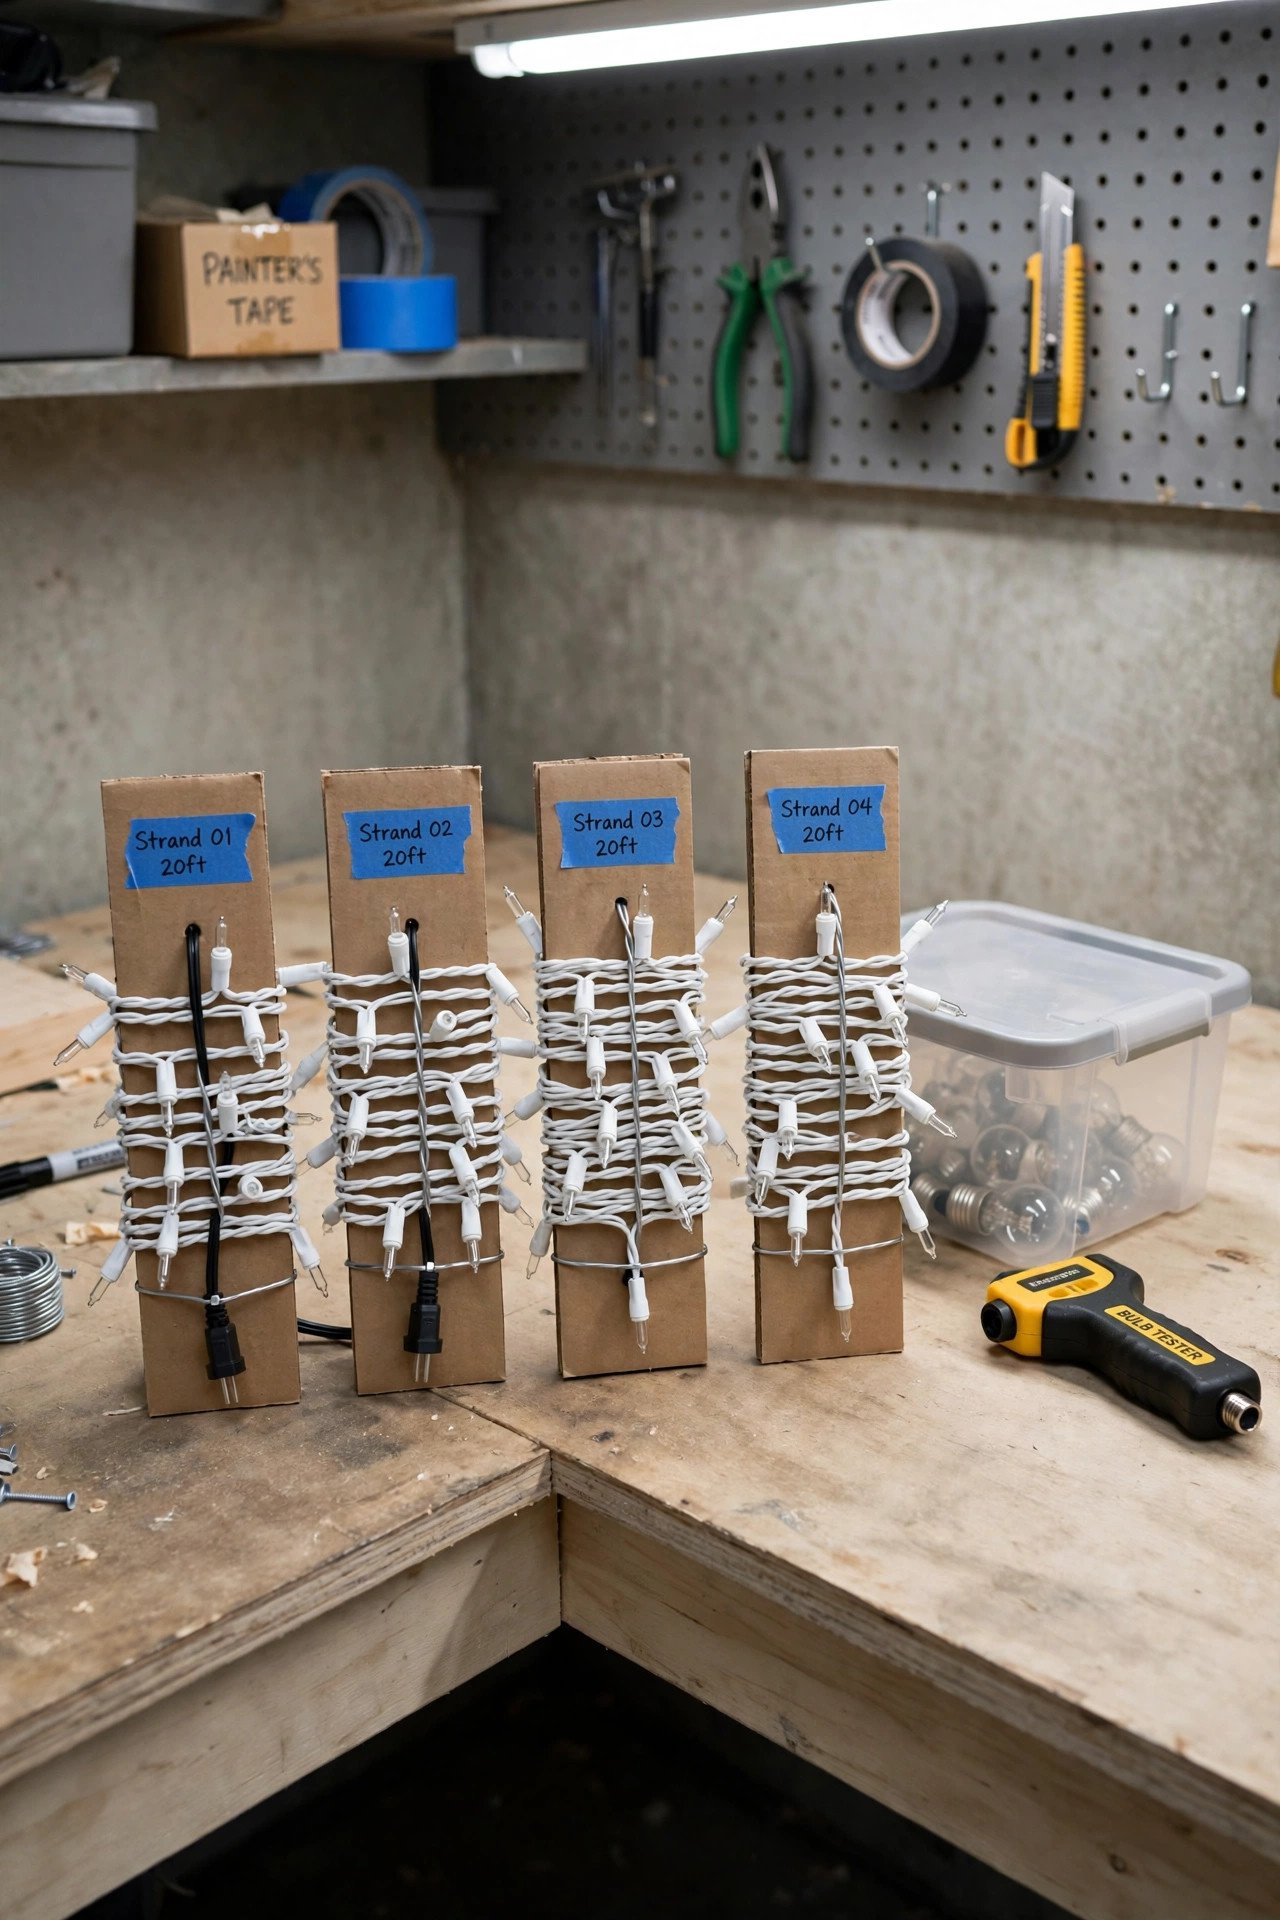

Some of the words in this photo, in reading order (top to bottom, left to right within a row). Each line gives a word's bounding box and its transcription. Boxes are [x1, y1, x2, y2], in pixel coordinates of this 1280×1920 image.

[202, 250, 324, 286] PAINTER'S
[226, 295, 294, 326] TAPE
[781, 797, 841, 819] Strand
[848, 797, 873, 816] 04
[359, 819, 422, 843] Strand
[429, 819, 453, 838] 02
[573, 810, 634, 832] Strand
[640, 809, 664, 829] 03
[802, 822, 844, 843] 20ft
[135, 827, 202, 851] Strand
[210, 826, 231, 846] 01
[596, 835, 639, 857] 20ft
[160, 852, 207, 877] 20ft
[383, 845, 427, 867] 20ft
[1116, 1309, 1154, 1332] BULB
[1153, 1323, 1204, 1361] TESTER
